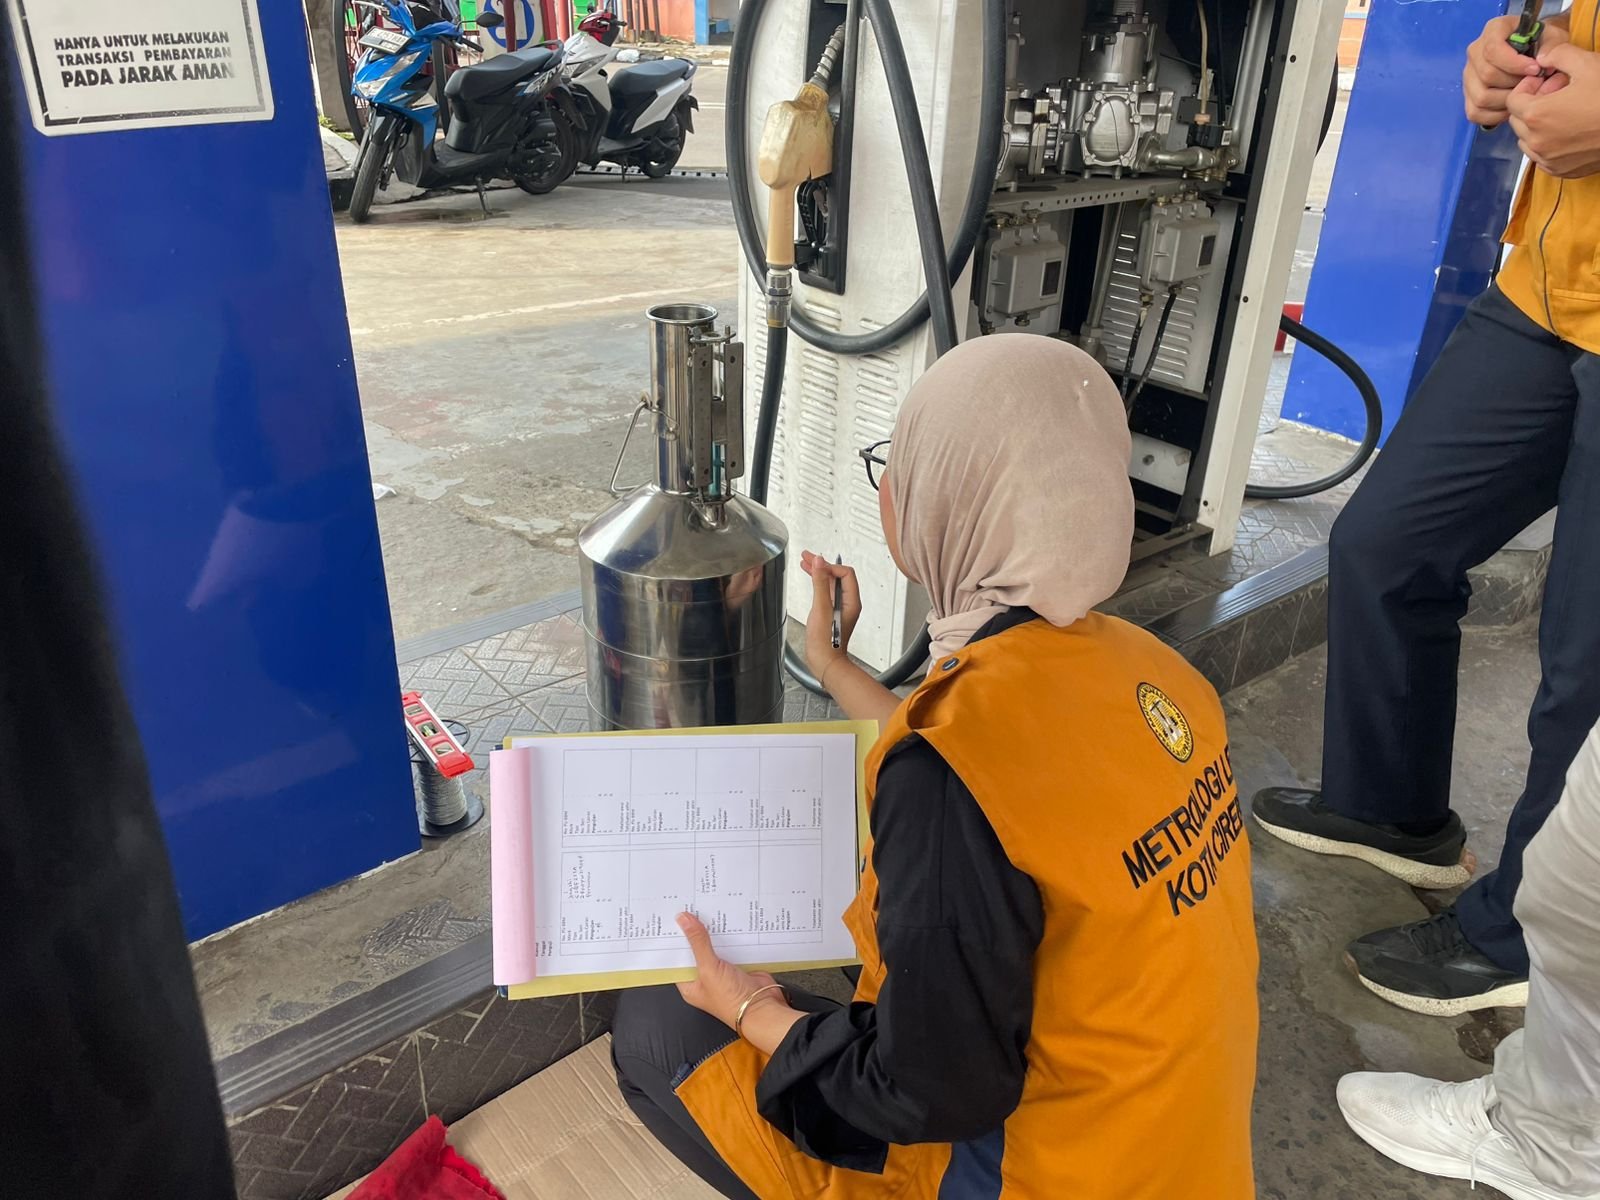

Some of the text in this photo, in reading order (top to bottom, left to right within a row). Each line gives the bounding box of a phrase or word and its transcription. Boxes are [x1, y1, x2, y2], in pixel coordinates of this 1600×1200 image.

[54, 31, 230, 50] HANYA UNTUK MELAKUKAN
[57, 47, 231, 66] TRANSAKSI PEMBAYARAN
[61, 62, 236, 88] PADA JARAK AMAN
[1121, 760, 1226, 889] METROLOGI
